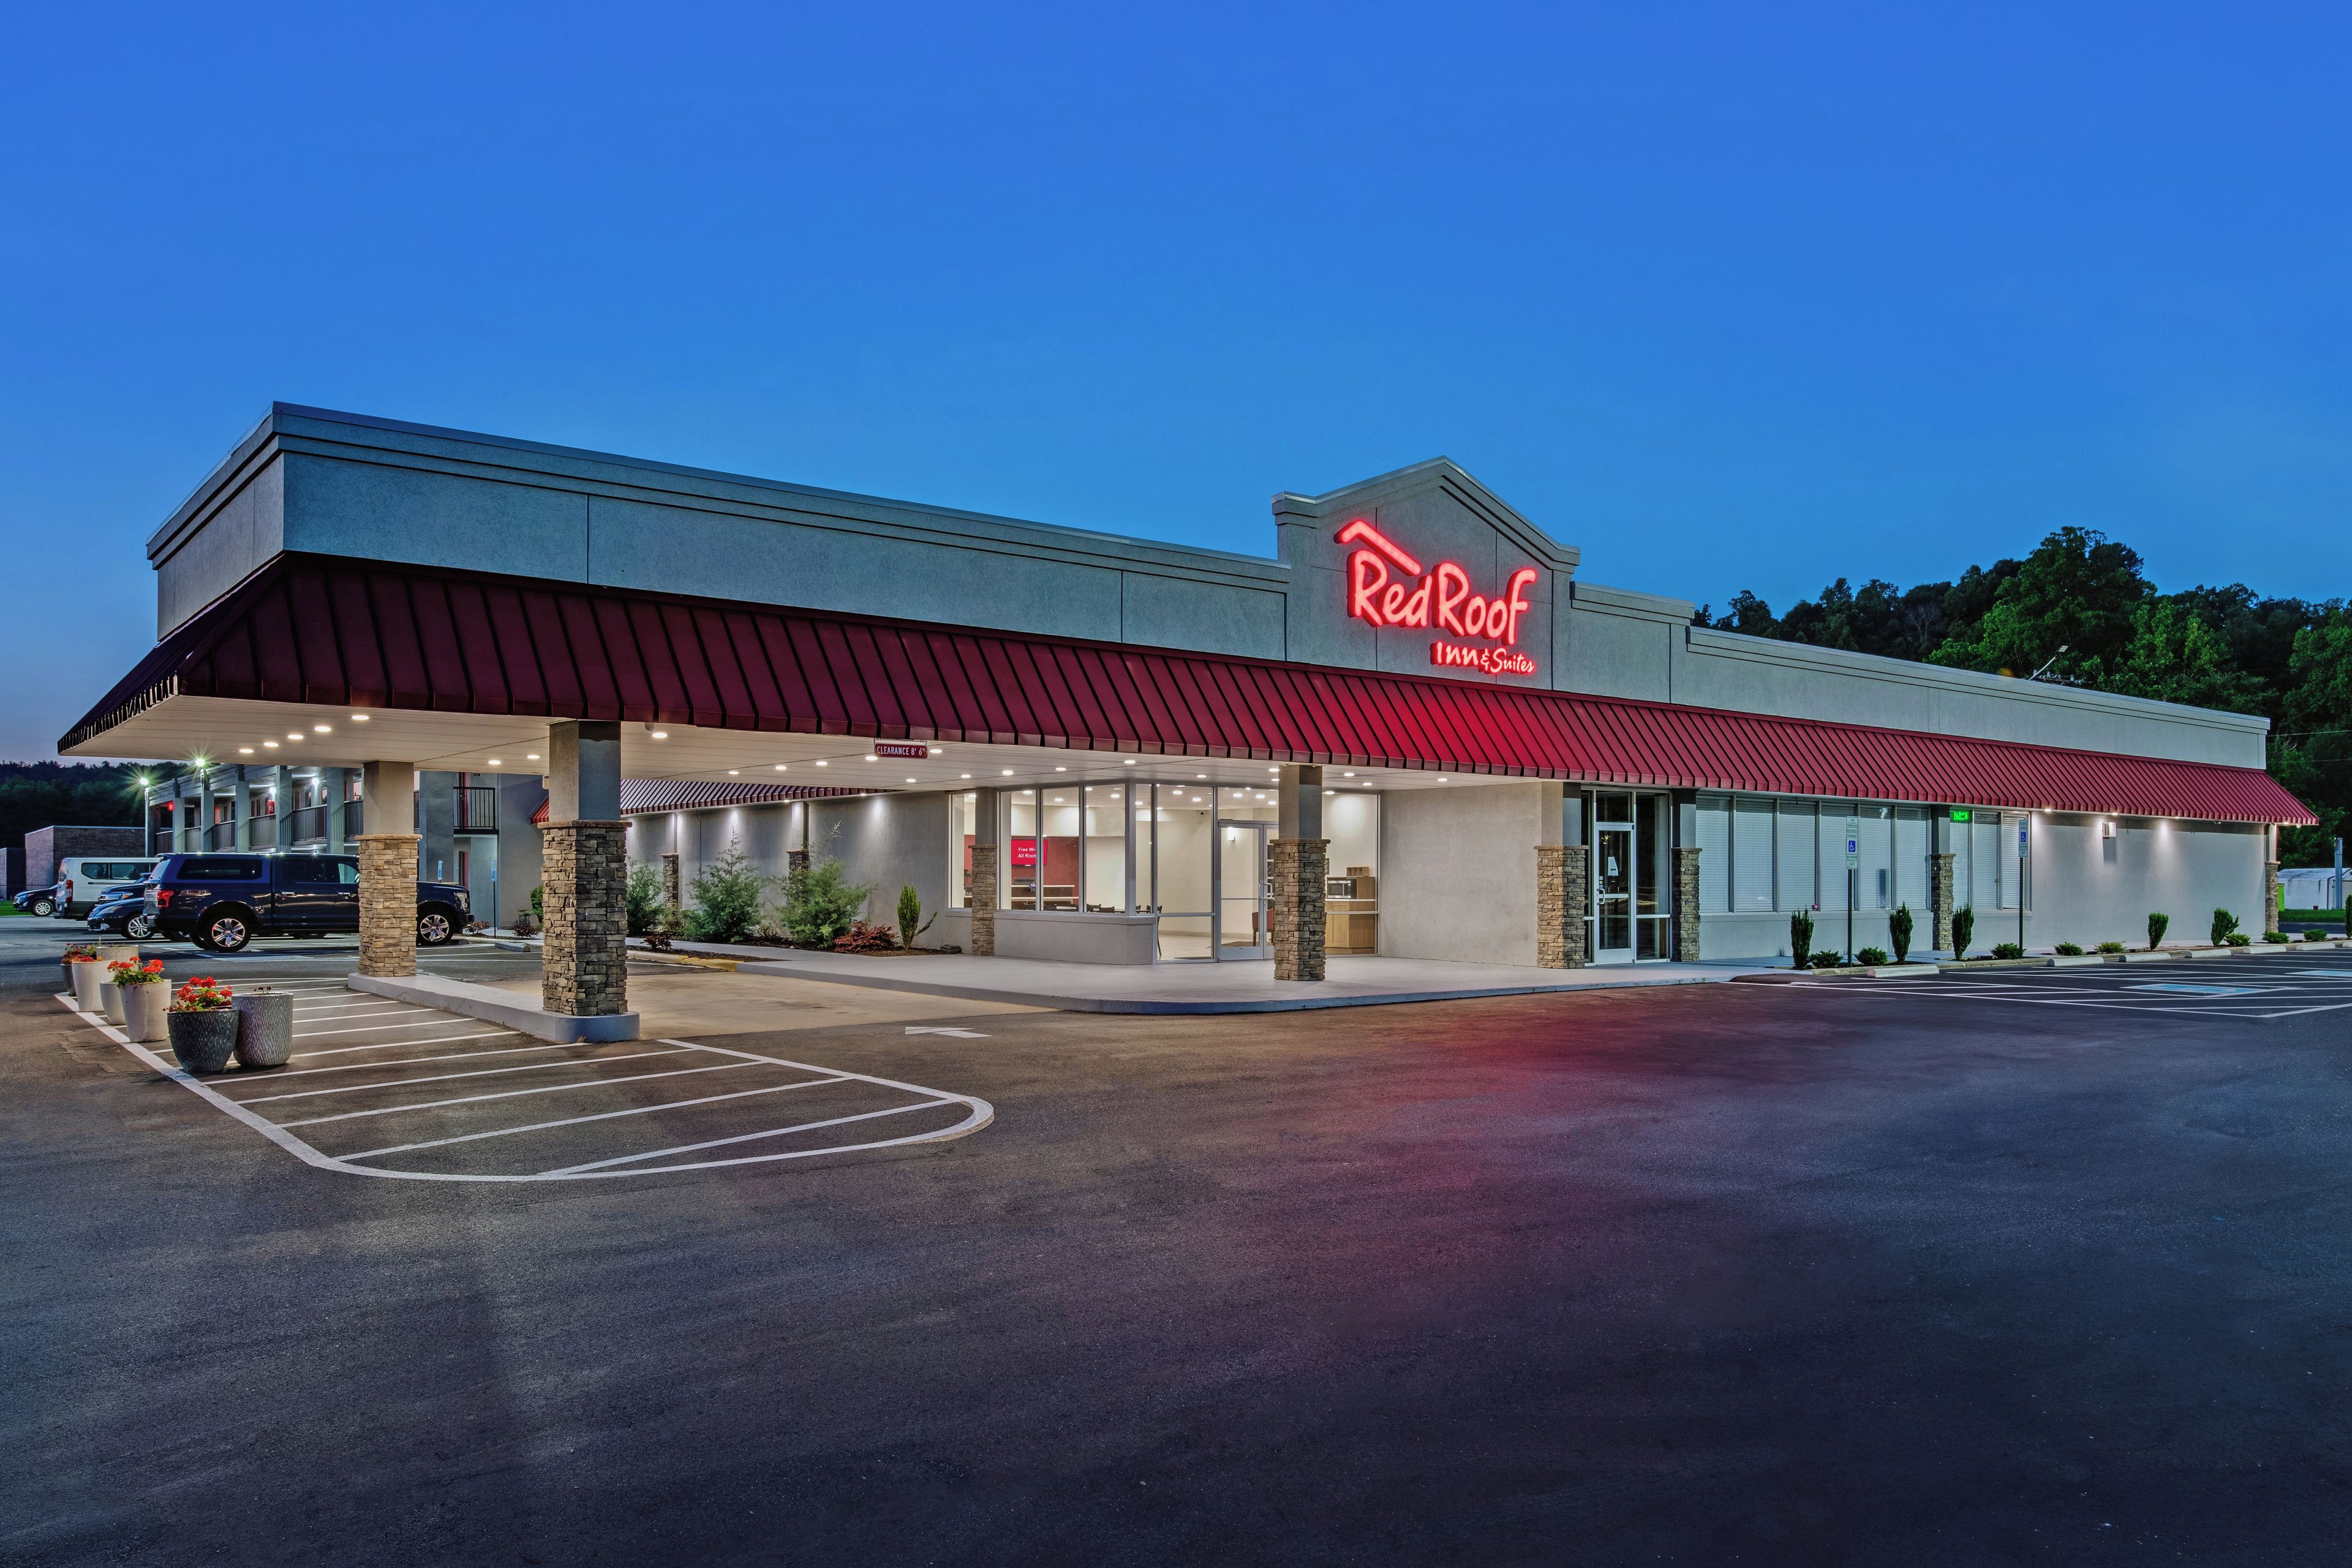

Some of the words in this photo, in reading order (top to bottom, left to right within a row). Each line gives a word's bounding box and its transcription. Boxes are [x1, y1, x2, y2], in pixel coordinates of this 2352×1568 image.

[1433, 641, 1479, 666] Inn
[1480, 648, 1490, 671] &
[1490, 647, 1535, 673] Suites
[876, 746, 910, 755] CLEARANCE
[919, 747, 925, 756] 6"
